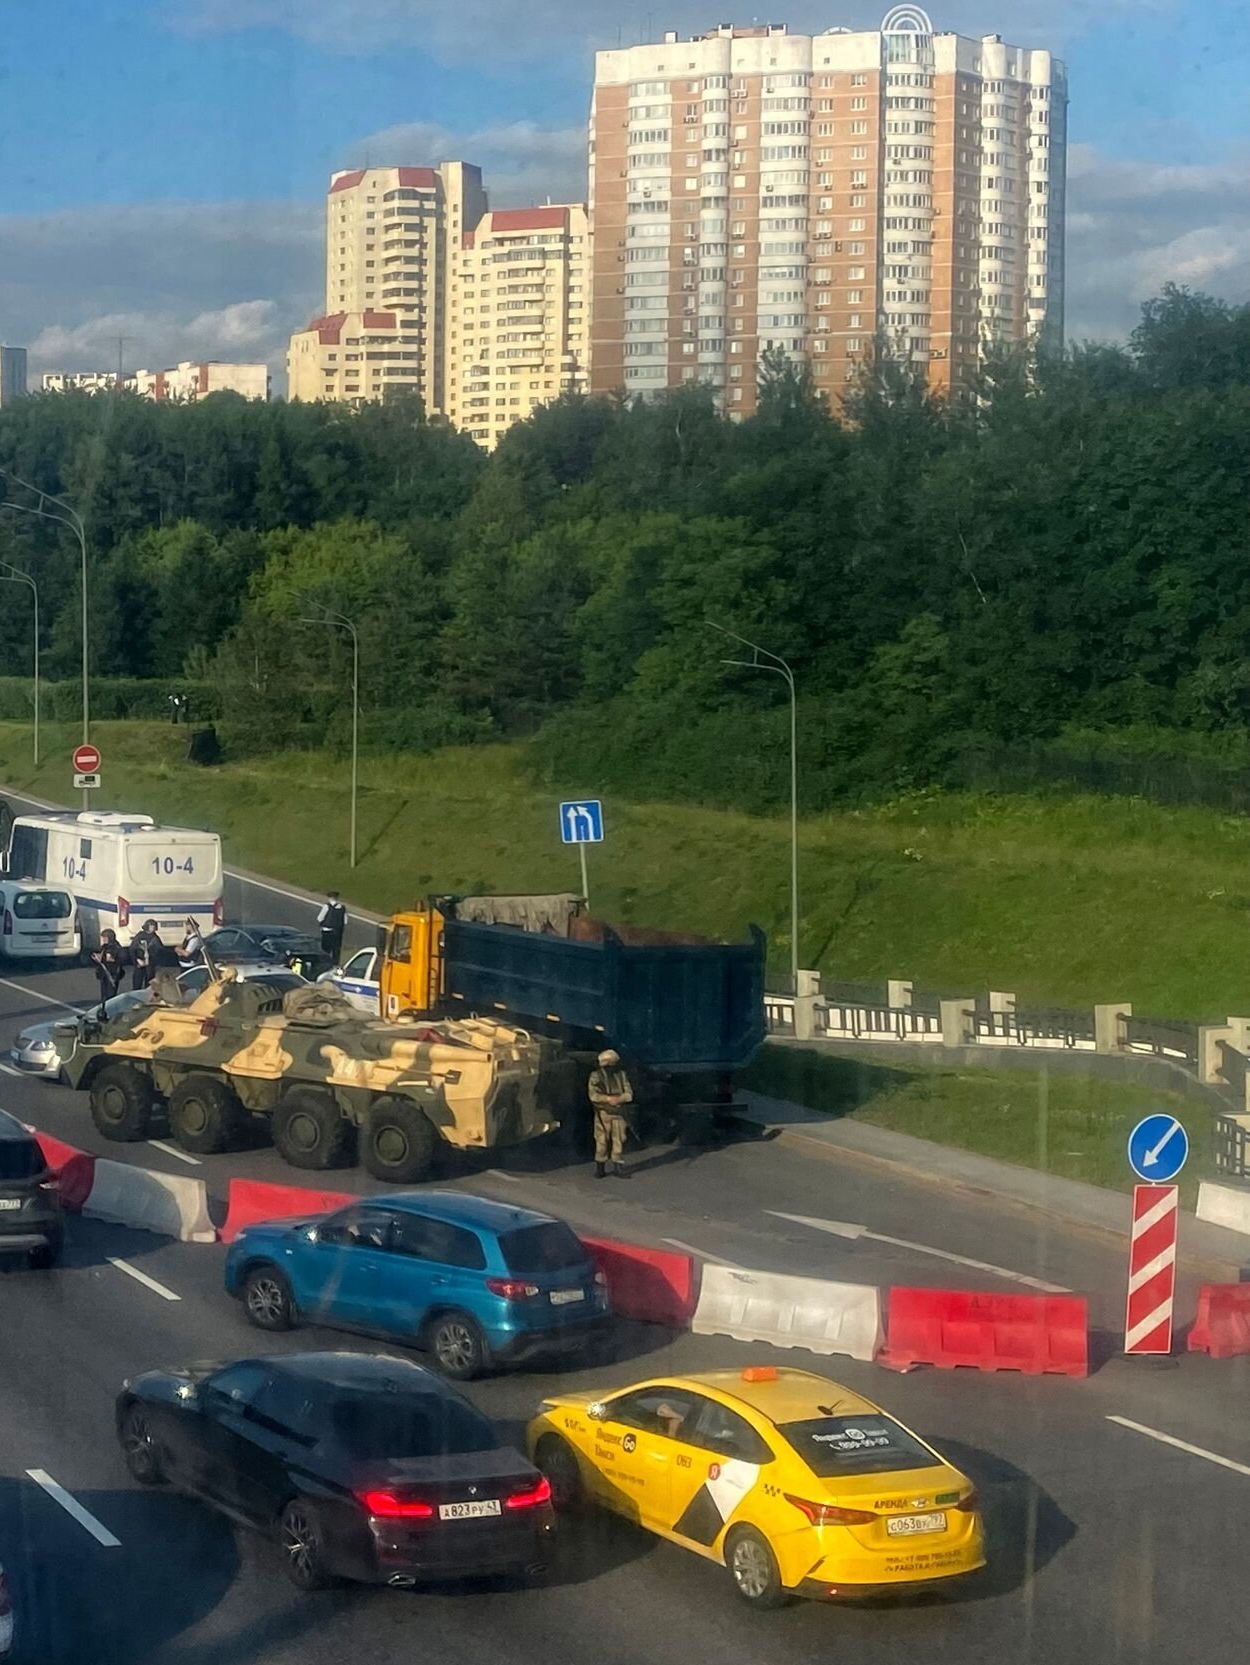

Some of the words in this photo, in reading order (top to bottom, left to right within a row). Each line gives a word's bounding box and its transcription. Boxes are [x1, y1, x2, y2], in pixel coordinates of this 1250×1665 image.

[63, 855, 86, 881] 10-4
[152, 856, 194, 875] 10-4
[623, 1435, 636, 1451] Go
[874, 1499, 908, 1509] АРЕНДА
